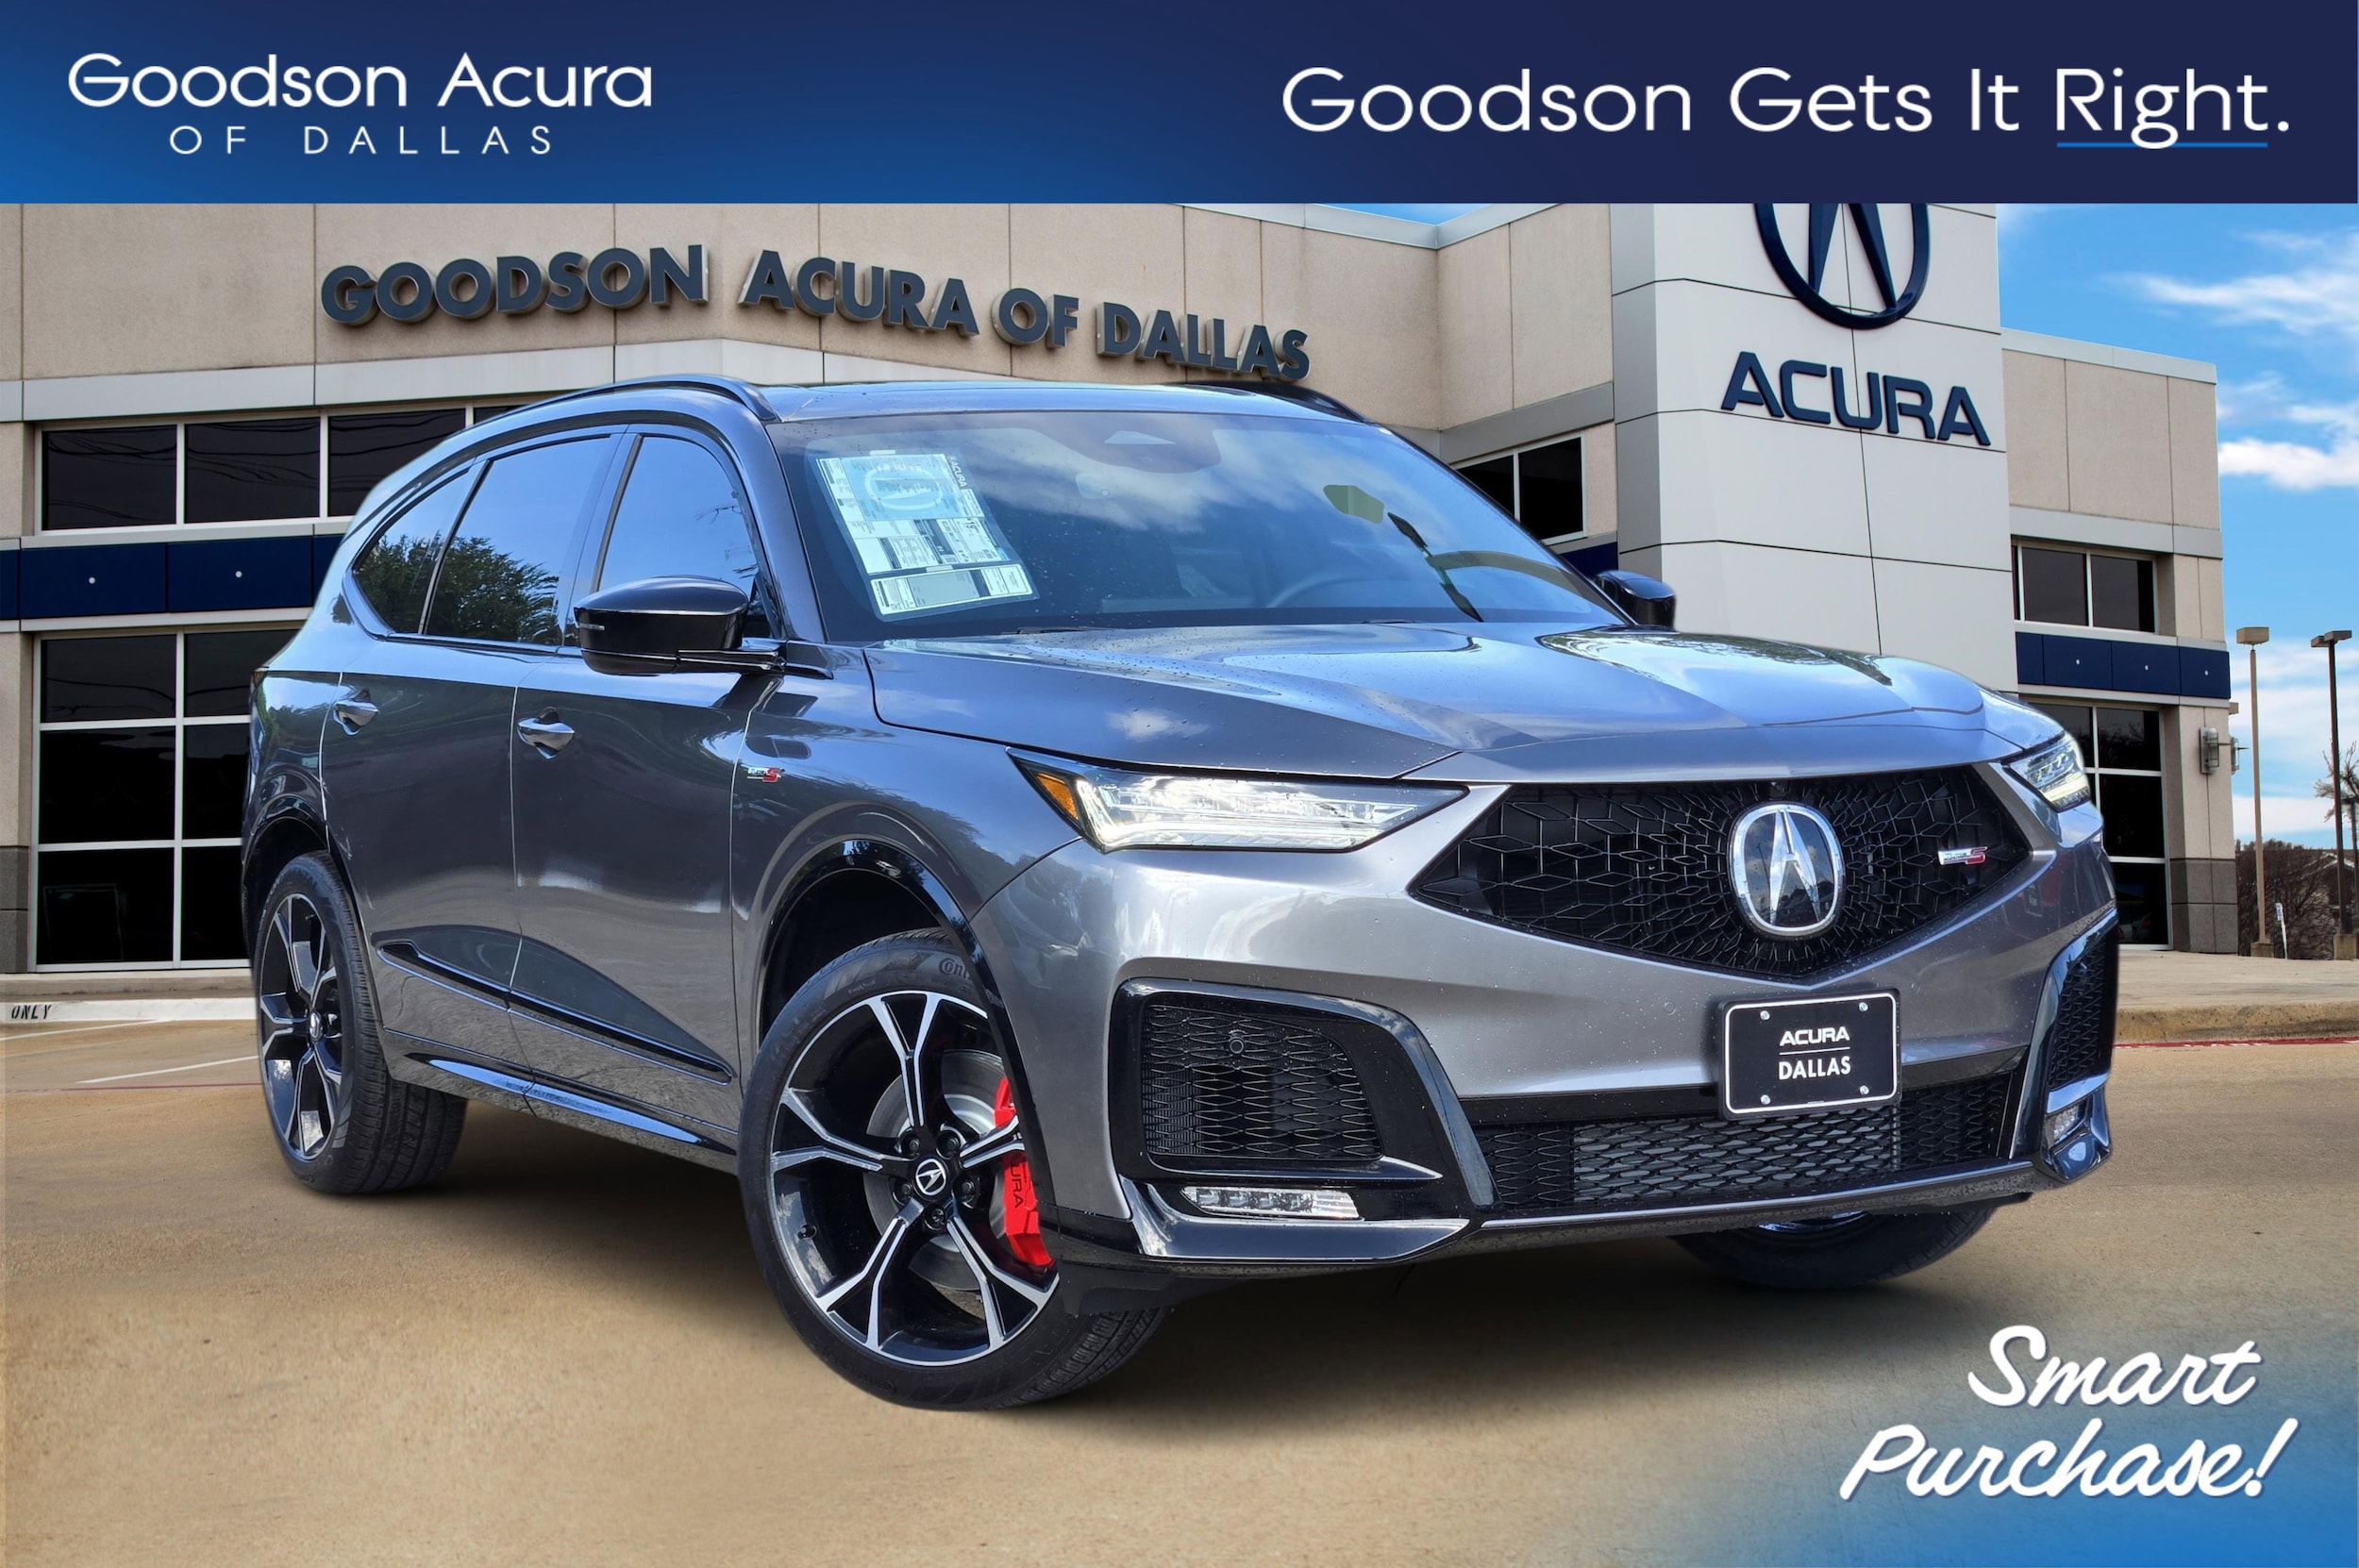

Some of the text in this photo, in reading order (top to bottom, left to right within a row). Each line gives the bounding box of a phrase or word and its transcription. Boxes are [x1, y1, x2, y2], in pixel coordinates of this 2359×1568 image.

[321, 244, 1310, 379] GOODSON ACURA OF DALLAS
[1720, 350, 1991, 446] ACURA
[11, 1004, 52, 1020] ONLY
[1779, 1026, 1850, 1046] ACURA
[1778, 1055, 1851, 1080] DALLAS
[1010, 1163, 1024, 1209] URA
